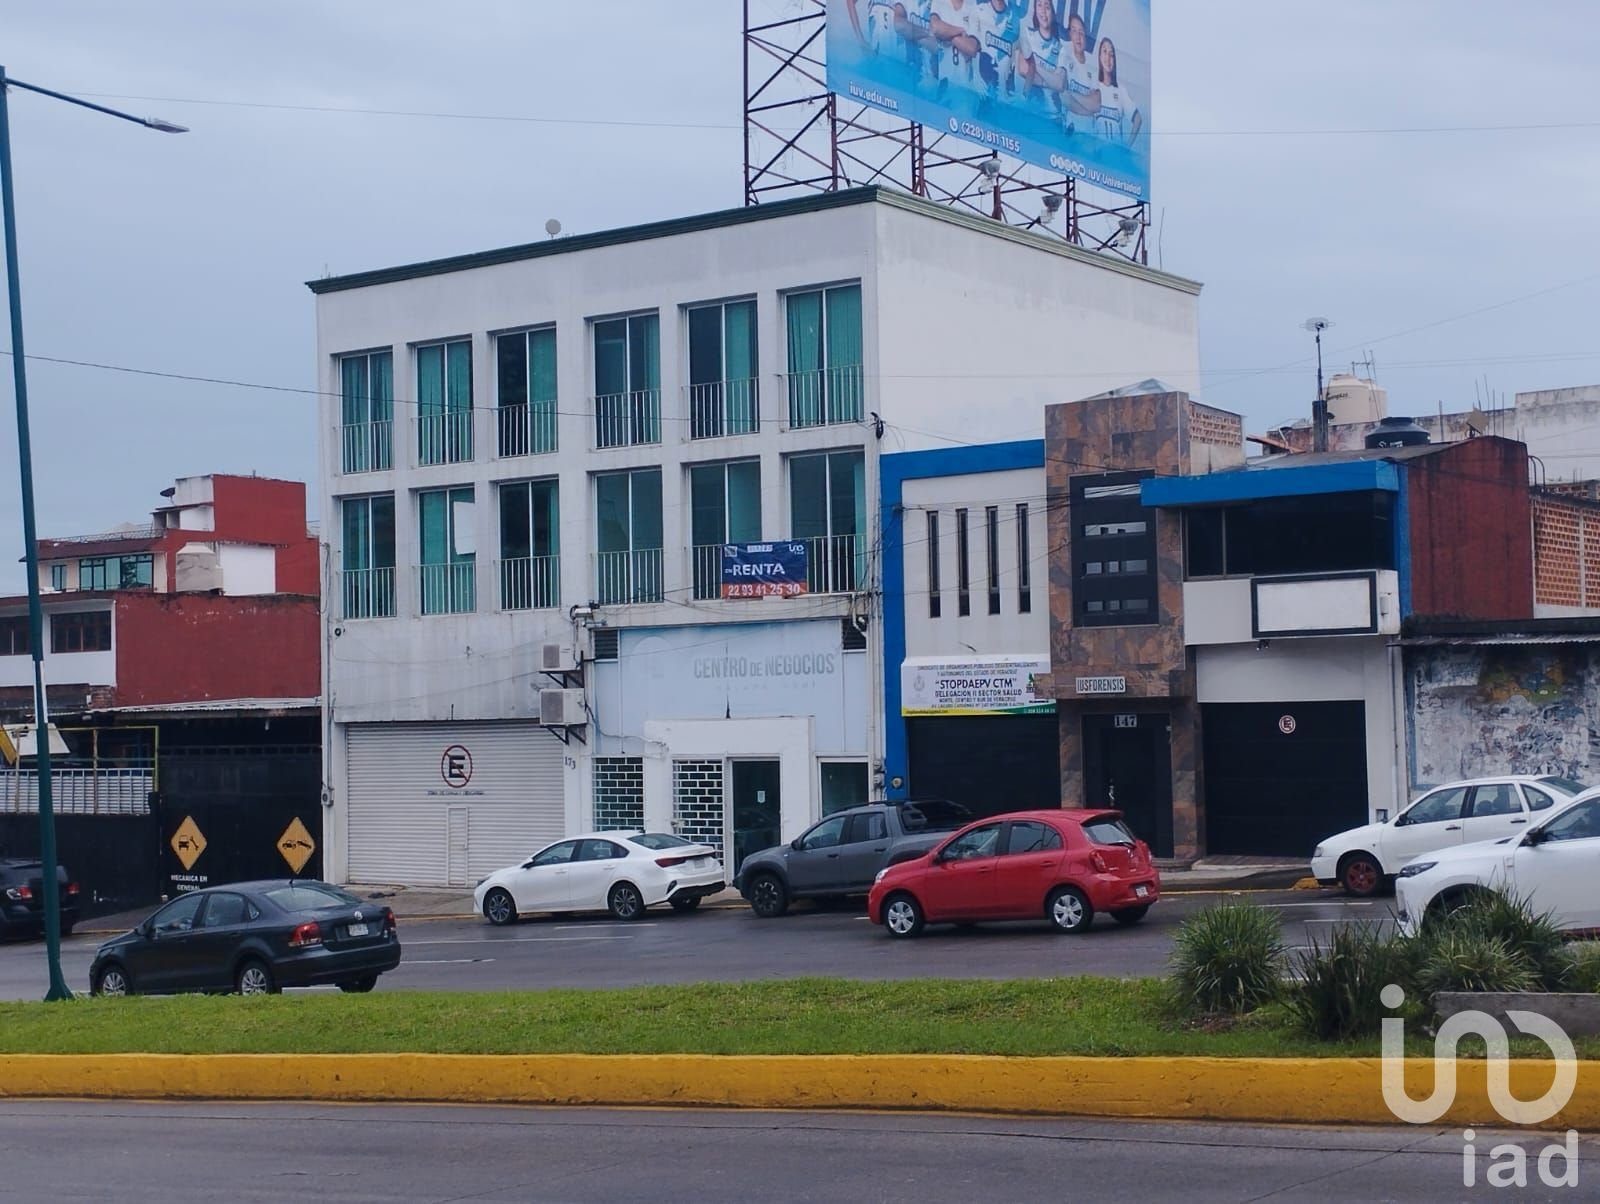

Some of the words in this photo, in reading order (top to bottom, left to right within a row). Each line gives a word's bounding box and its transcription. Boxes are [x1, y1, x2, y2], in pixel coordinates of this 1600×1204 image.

[848, 81, 898, 110] iuv.edu.mx
[961, 121, 985, 141] (228)
[986, 130, 1000, 146] 811
[1001, 136, 1020, 153] 1155
[733, 563, 786, 576] RENTA
[728, 585, 740, 596] 22
[741, 584, 753, 596] 93
[755, 584, 766, 595] 41
[770, 583, 783, 595] 25
[786, 583, 801, 595] 30
[694, 656, 747, 679] CENTRO
[750, 662, 762, 677] DE
[765, 652, 835, 677] NEGOCIOS
[1077, 679, 1125, 692] IUSFORENSIS
[448, 755, 466, 778] E
[564, 757, 576, 770] 173
